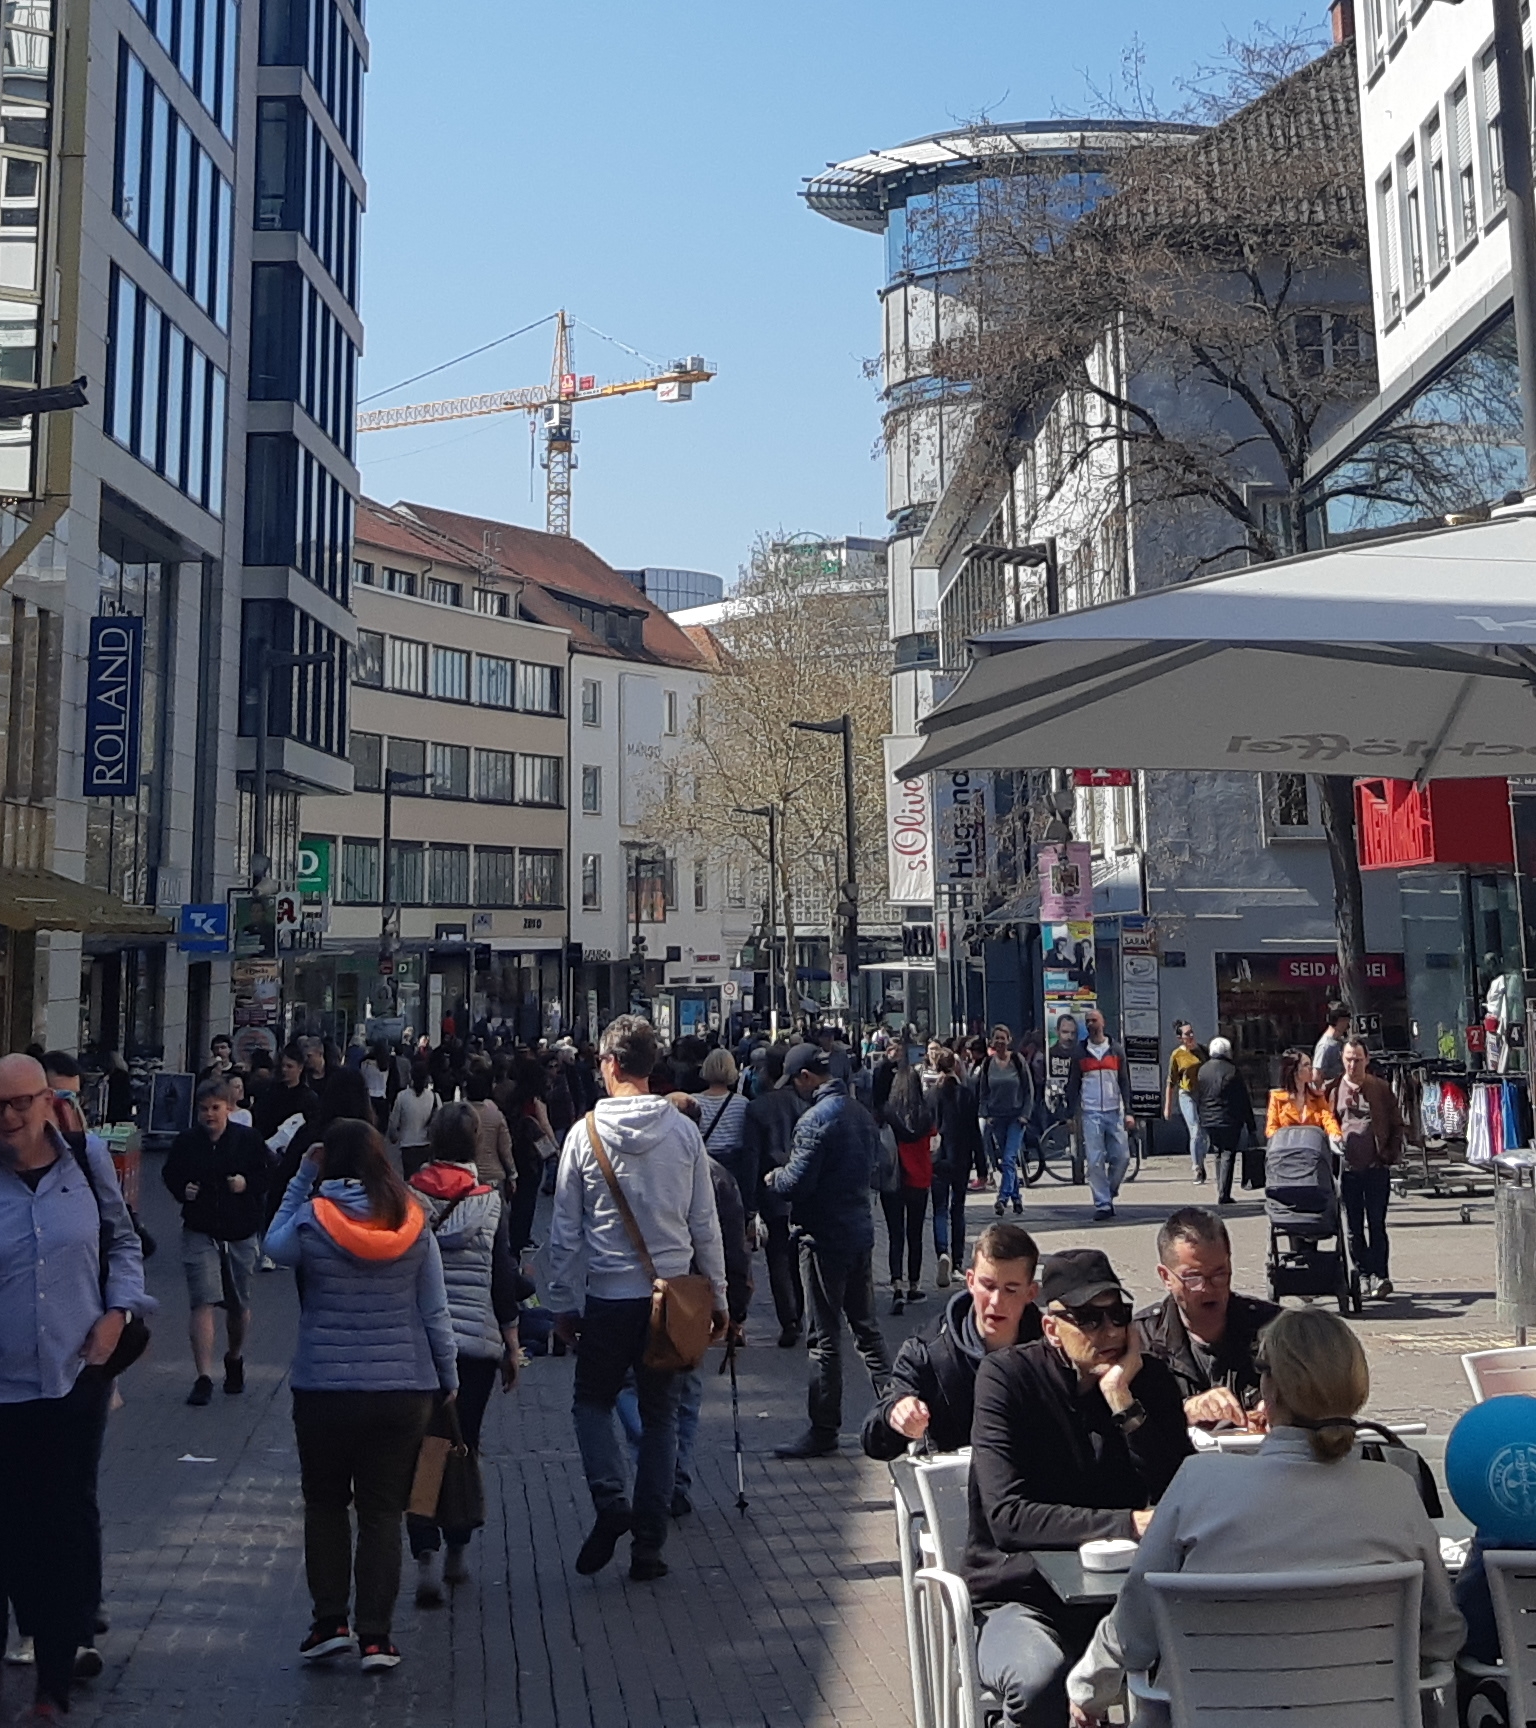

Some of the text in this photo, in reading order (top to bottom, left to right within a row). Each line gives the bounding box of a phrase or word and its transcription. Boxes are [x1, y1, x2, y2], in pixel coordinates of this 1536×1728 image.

[92, 627, 129, 785] ROLAND
[892, 775, 929, 872] s.Olive
[949, 770, 973, 878] Hugnd
[190, 913, 218, 934] TK
[1290, 962, 1326, 977] SEID
